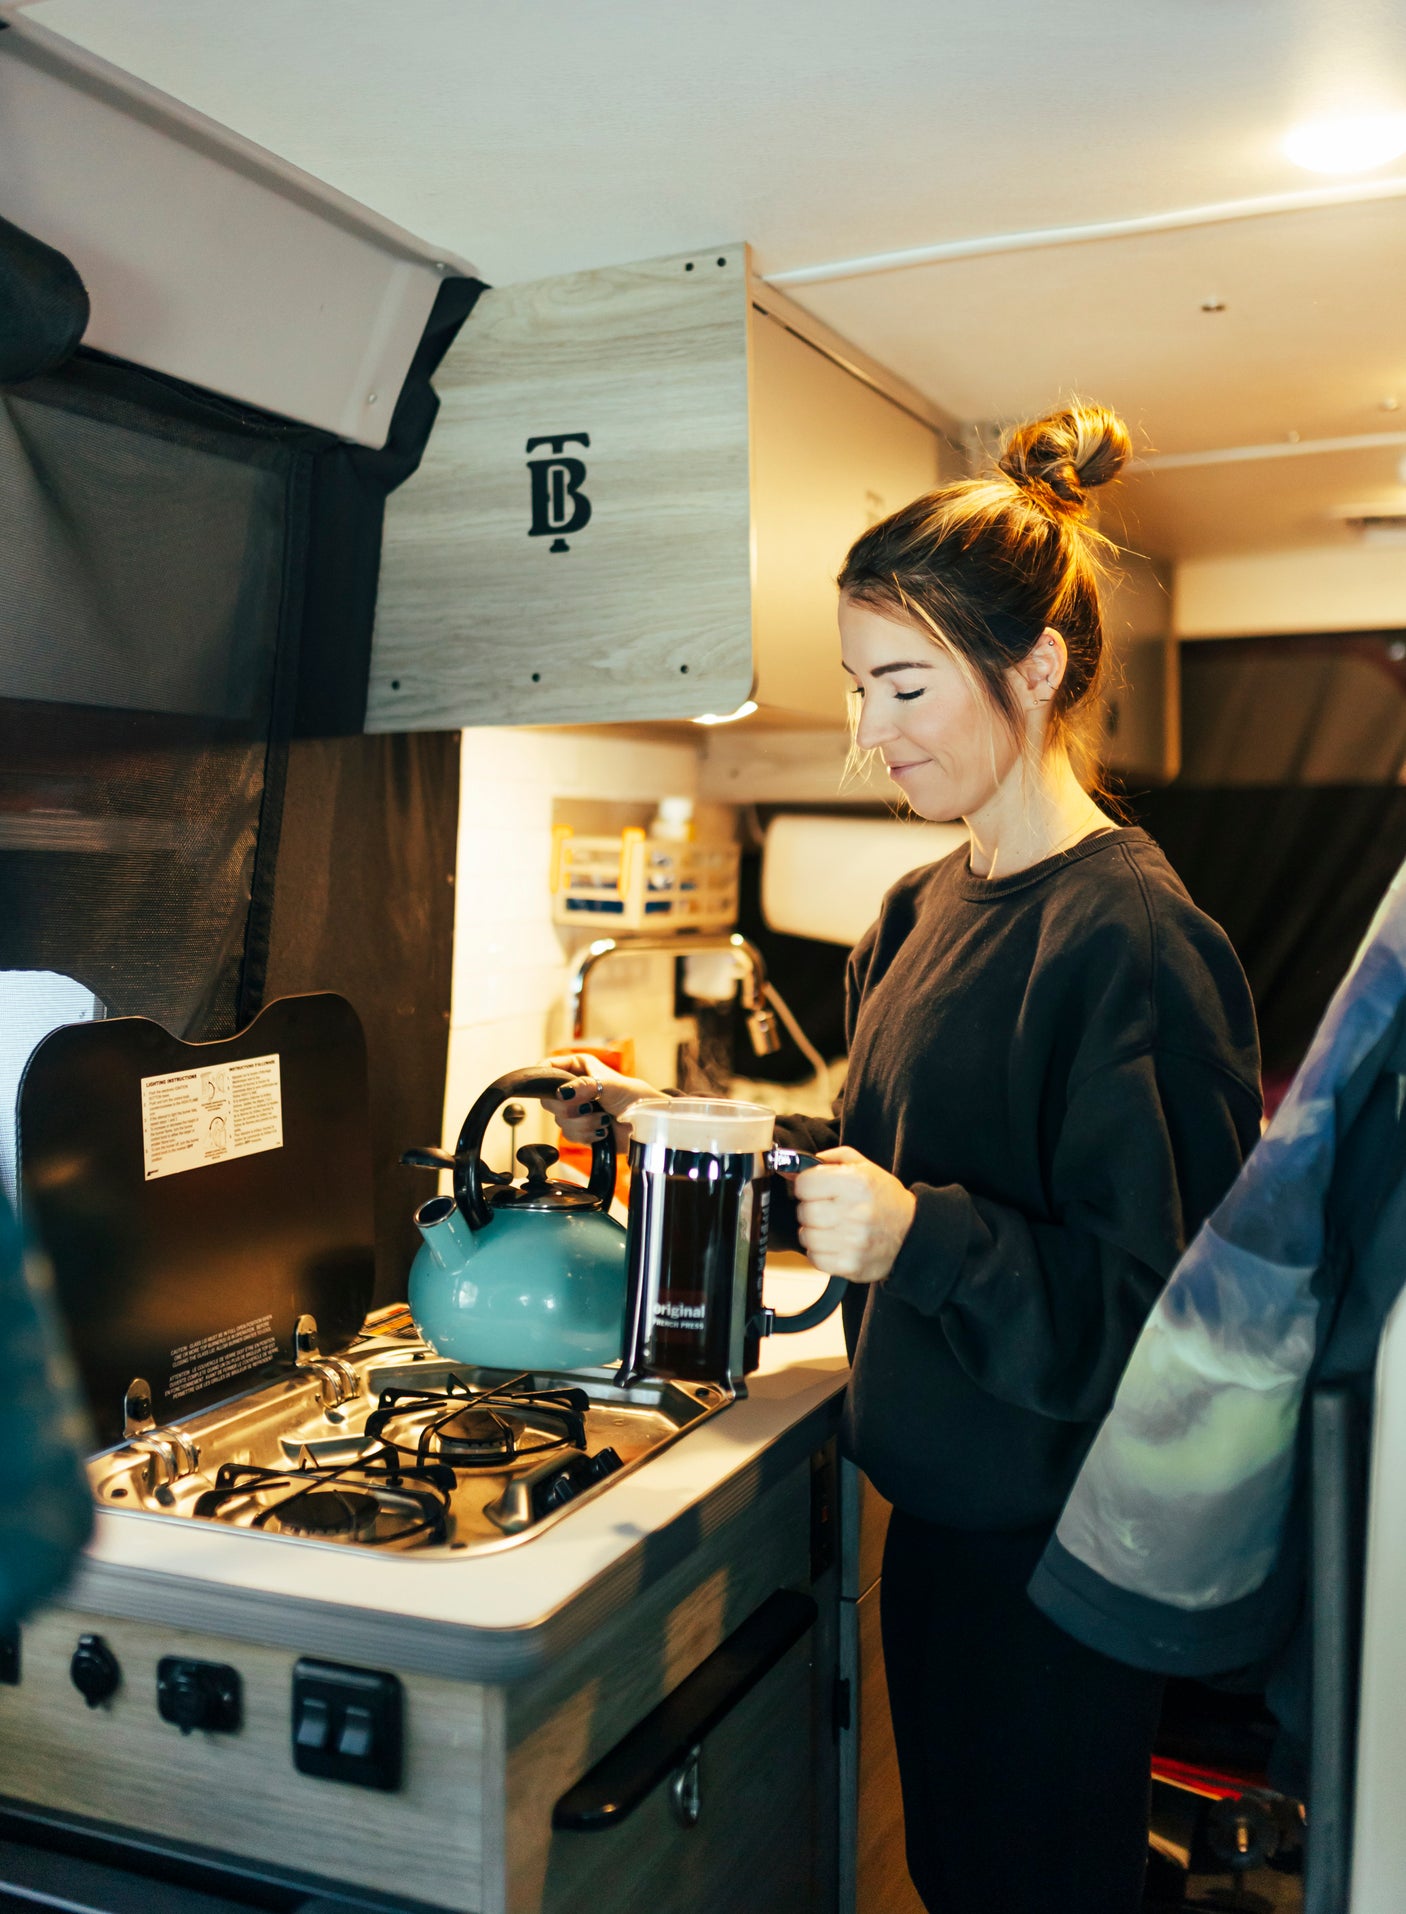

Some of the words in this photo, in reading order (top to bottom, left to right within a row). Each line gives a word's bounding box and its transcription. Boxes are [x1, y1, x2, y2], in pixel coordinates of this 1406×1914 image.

[145, 1079, 166, 1088] LIGHTING
[167, 1074, 197, 1084] INSTRUCTIONS
[653, 1301, 705, 1319] original
[680, 1320, 704, 1330] PRESS
